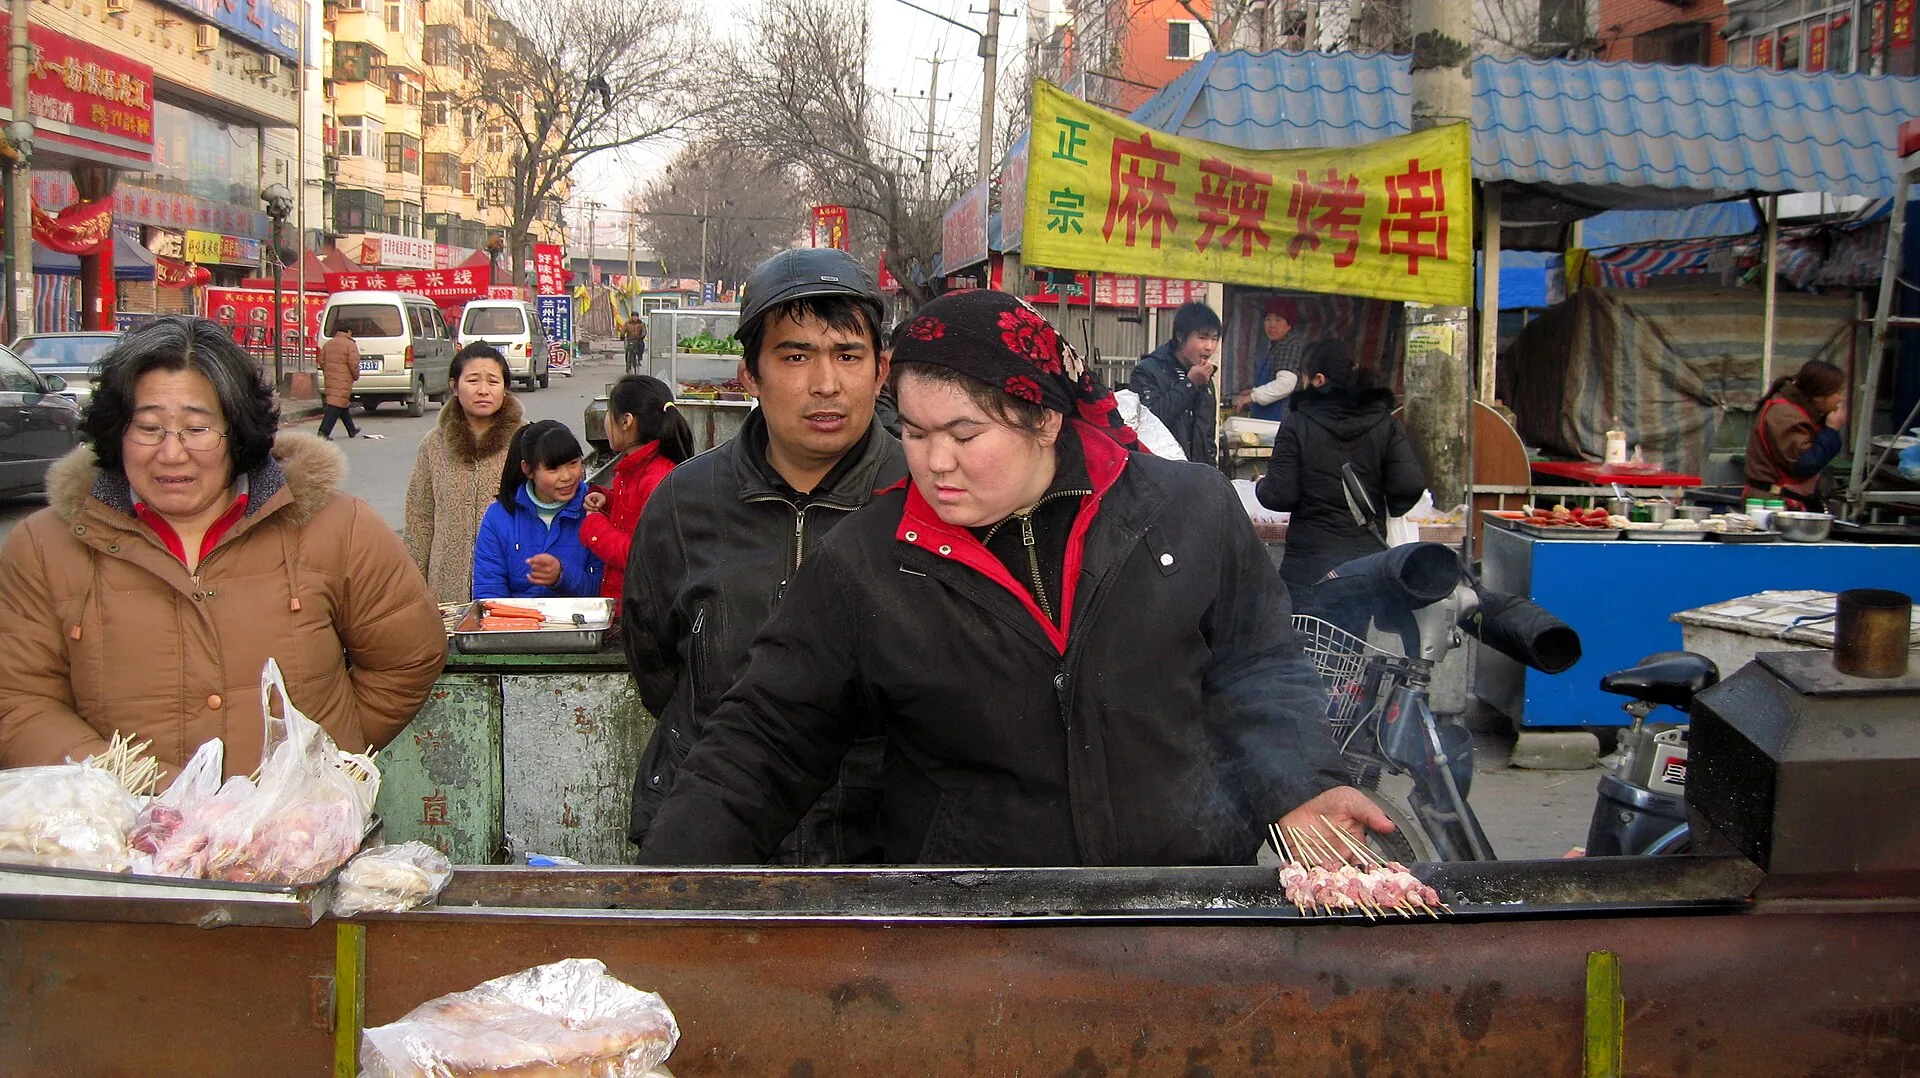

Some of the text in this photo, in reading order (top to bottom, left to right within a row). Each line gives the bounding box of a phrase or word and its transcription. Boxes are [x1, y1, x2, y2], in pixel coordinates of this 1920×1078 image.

[1047, 116, 1090, 235] 正宗
[1101, 132, 1449, 276] 麻辣烤串
[340, 269, 474, 291] 好味美米线
